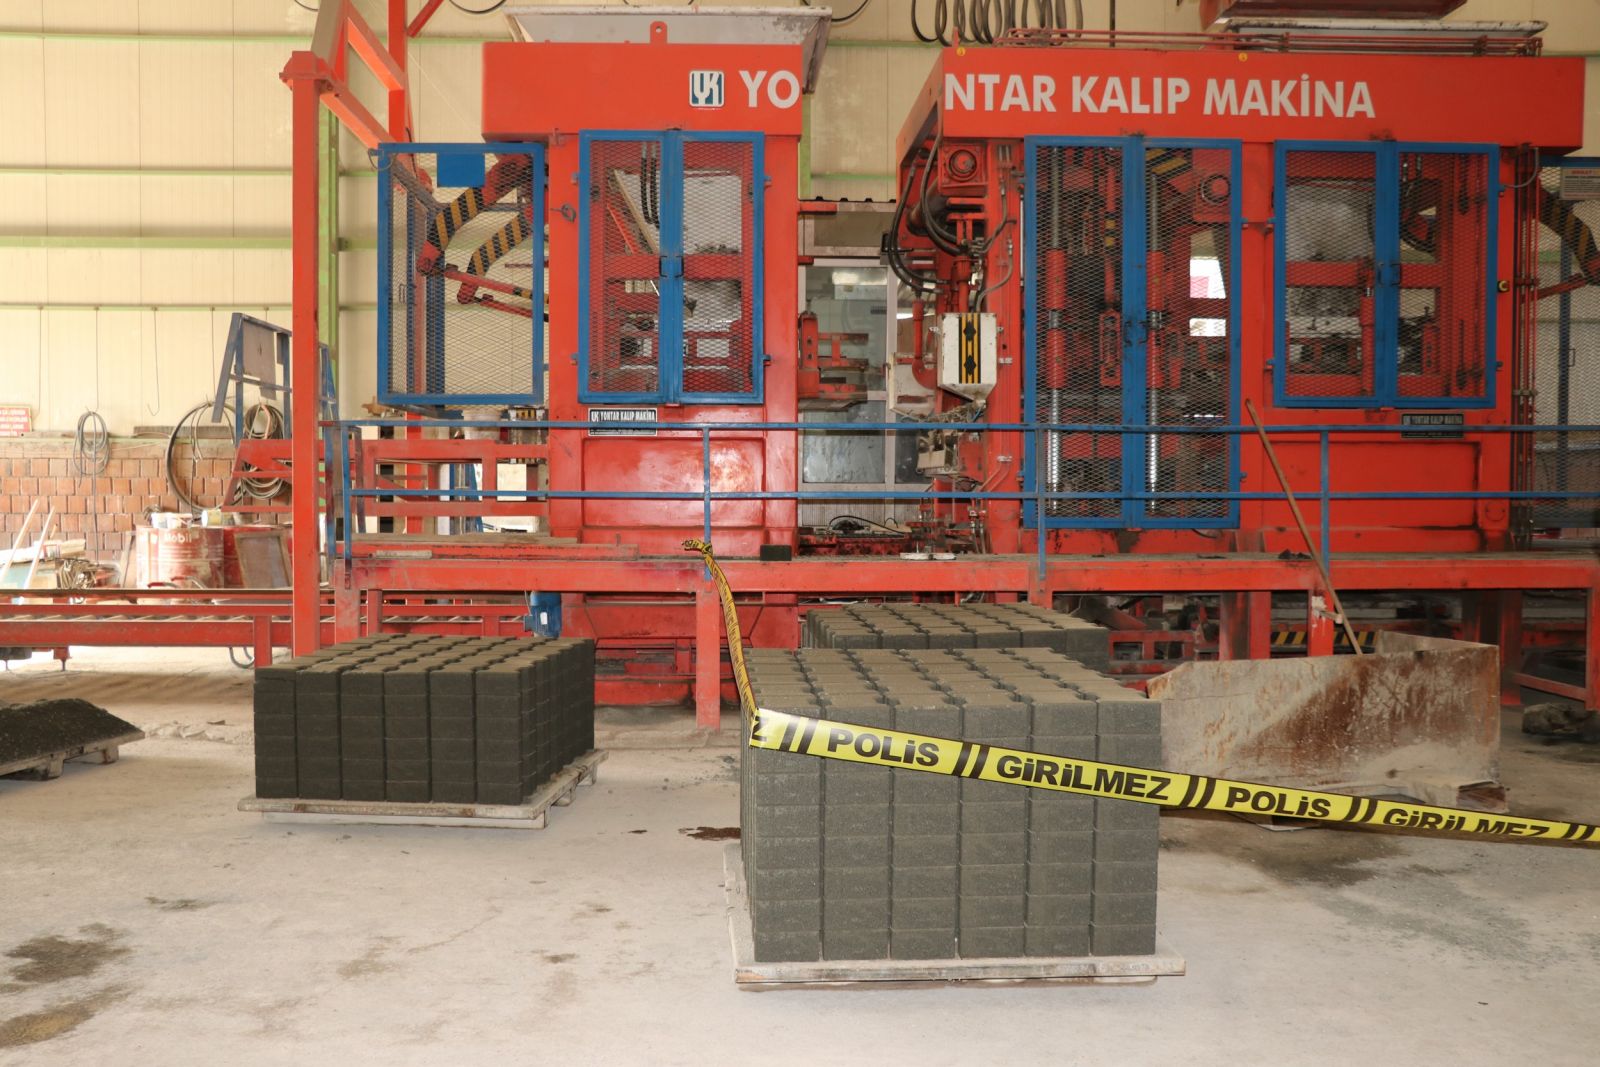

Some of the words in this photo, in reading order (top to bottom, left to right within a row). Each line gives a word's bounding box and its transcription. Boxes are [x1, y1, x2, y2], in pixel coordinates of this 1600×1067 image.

[738, 70, 800, 109] YO
[944, 73, 1056, 112] NTAR
[1072, 75, 1190, 115] KALIP
[1203, 73, 1376, 118] MAKİNA
